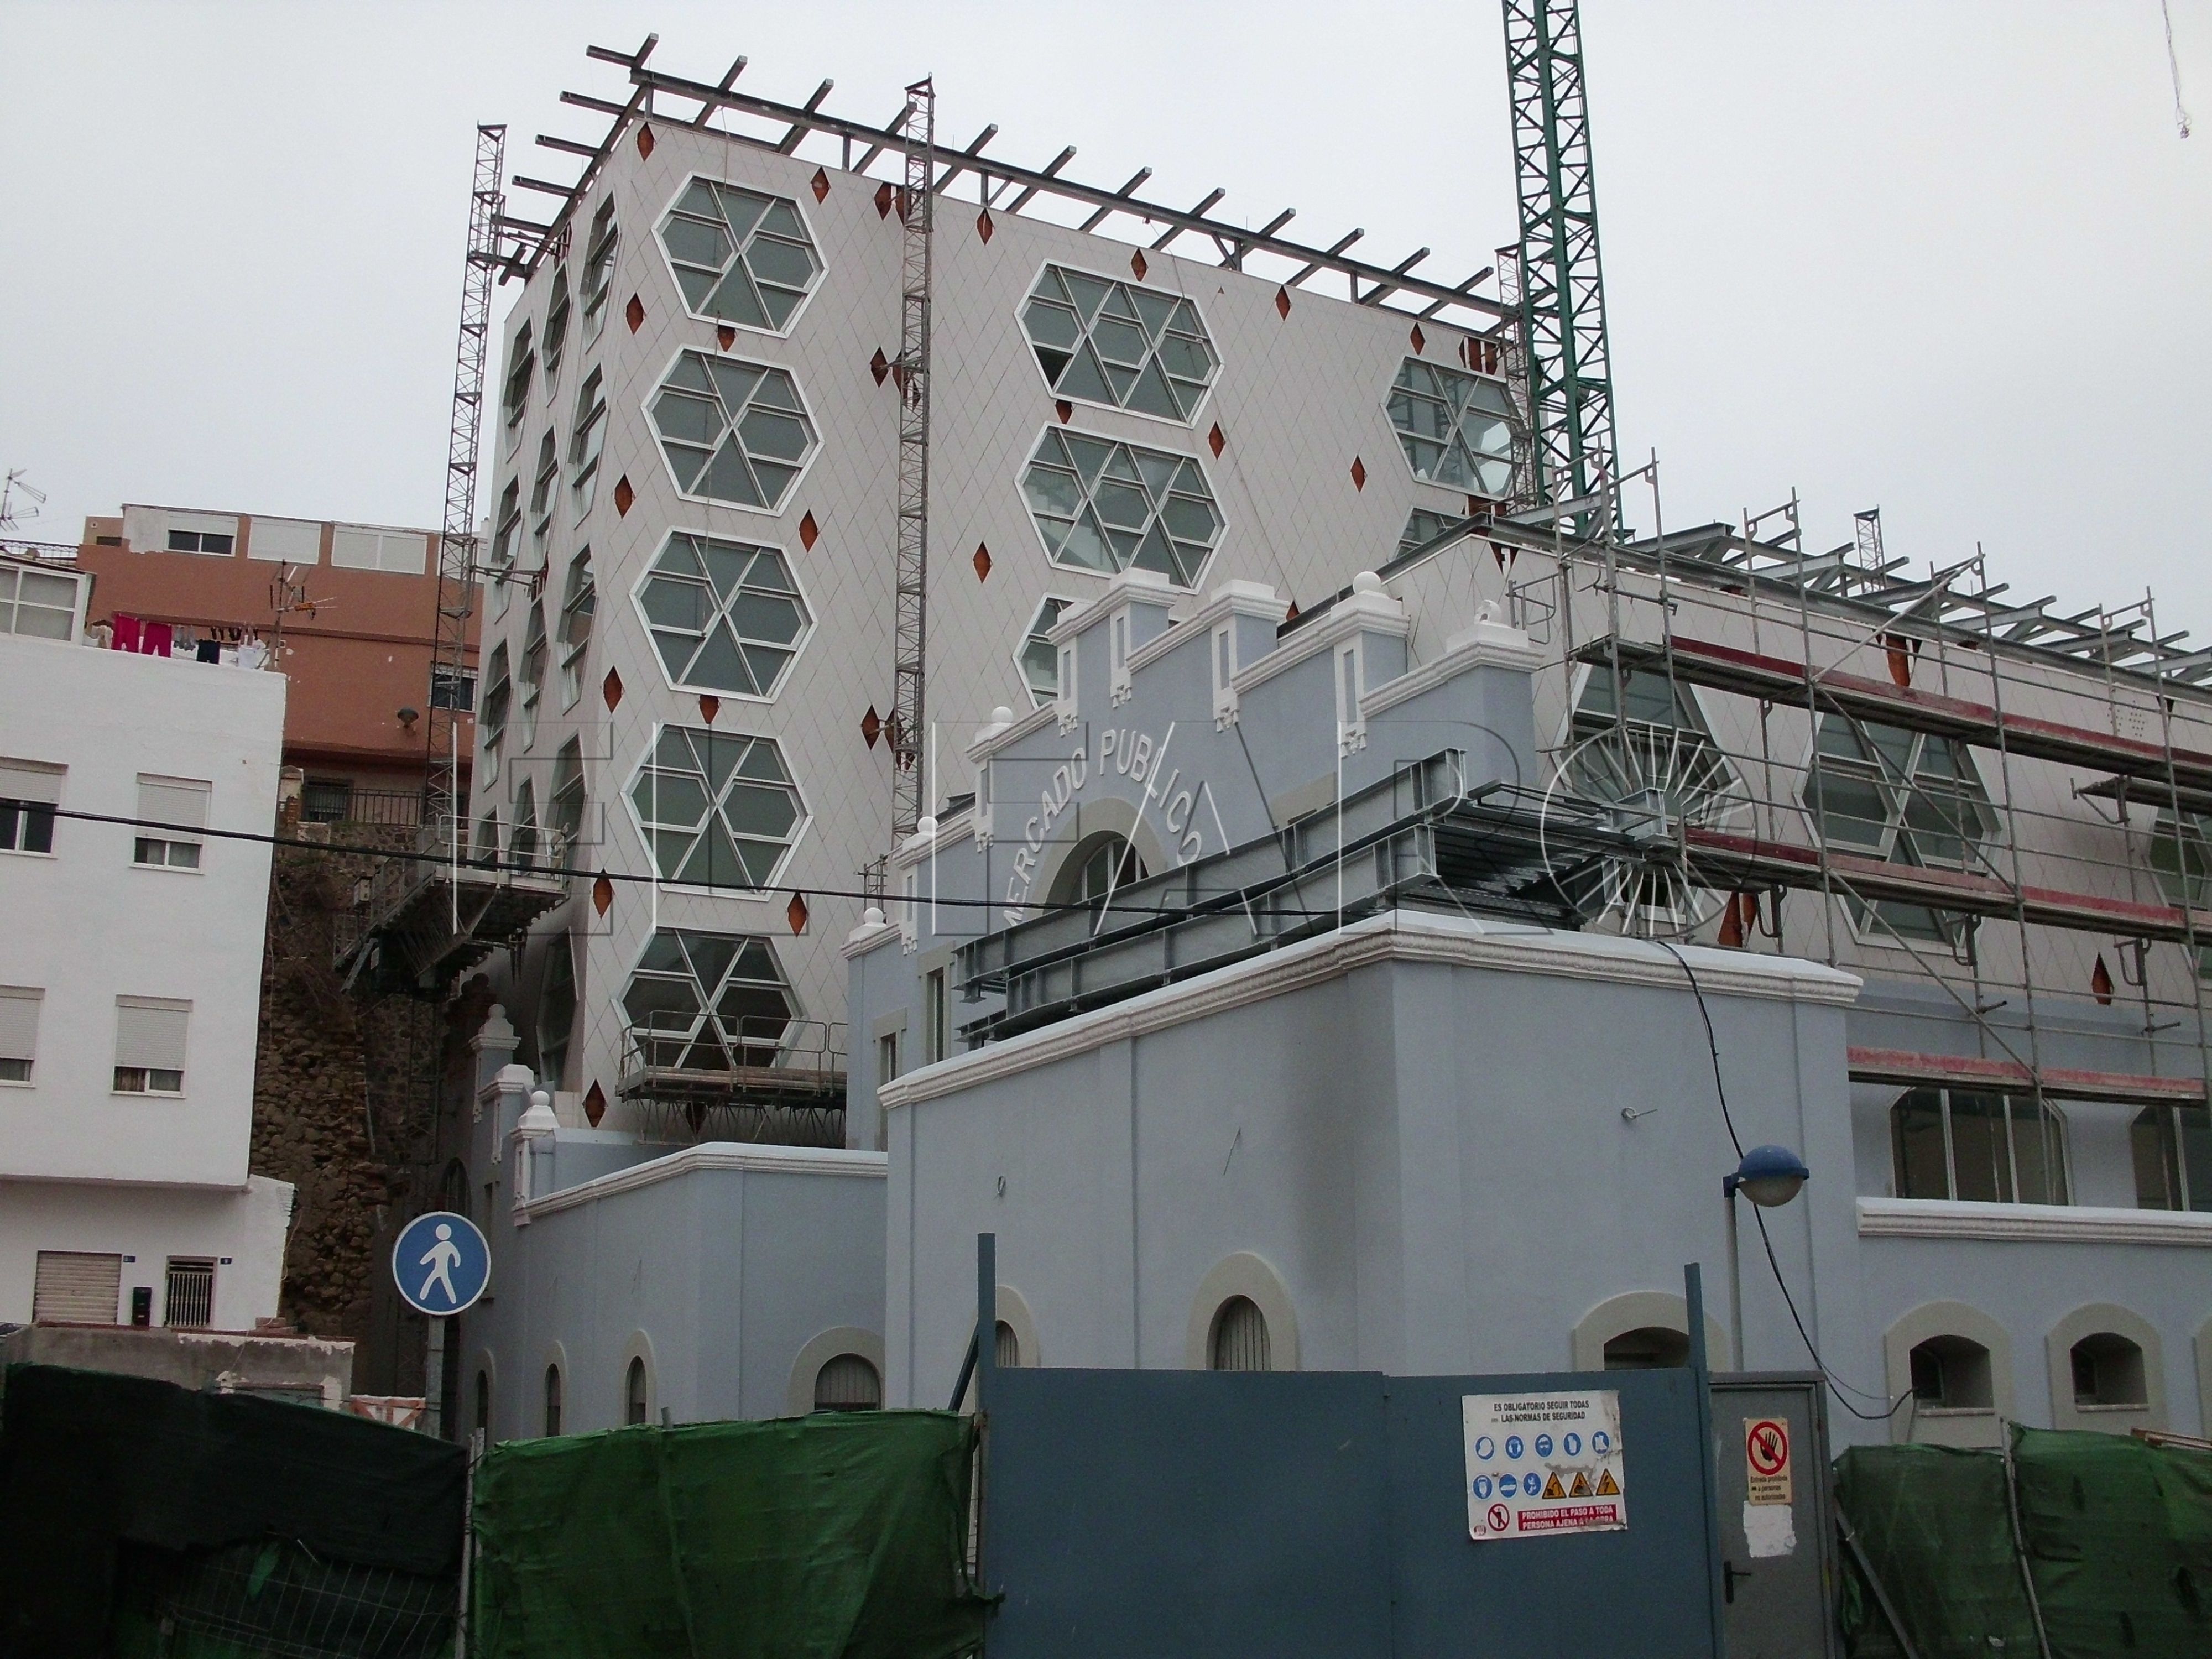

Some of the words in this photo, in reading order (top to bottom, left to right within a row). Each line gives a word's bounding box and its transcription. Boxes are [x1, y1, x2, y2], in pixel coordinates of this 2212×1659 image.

[1099, 729, 1202, 867] PUBLICO
[1494, 1403, 1502, 1412] ES
[1504, 1402, 1545, 1411] OBLIGATORIO
[1546, 1401, 1568, 1410] SEGUIR
[1569, 1400, 1589, 1409] TODAS
[1501, 1414, 1514, 1423] LAS
[1514, 1413, 1541, 1422] NORMAS
[1542, 1412, 1550, 1421] DE
[1552, 1411, 1585, 1421] SEGURIDAD
[1522, 1510, 1558, 1520] PROHIBIDO
[1561, 1509, 1569, 1517] EL
[1570, 1507, 1587, 1516] PASO
[1596, 1506, 1614, 1514] TODA
[1522, 1520, 1554, 1530] PERSONA
[1556, 1518, 1577, 1527] AJENA
